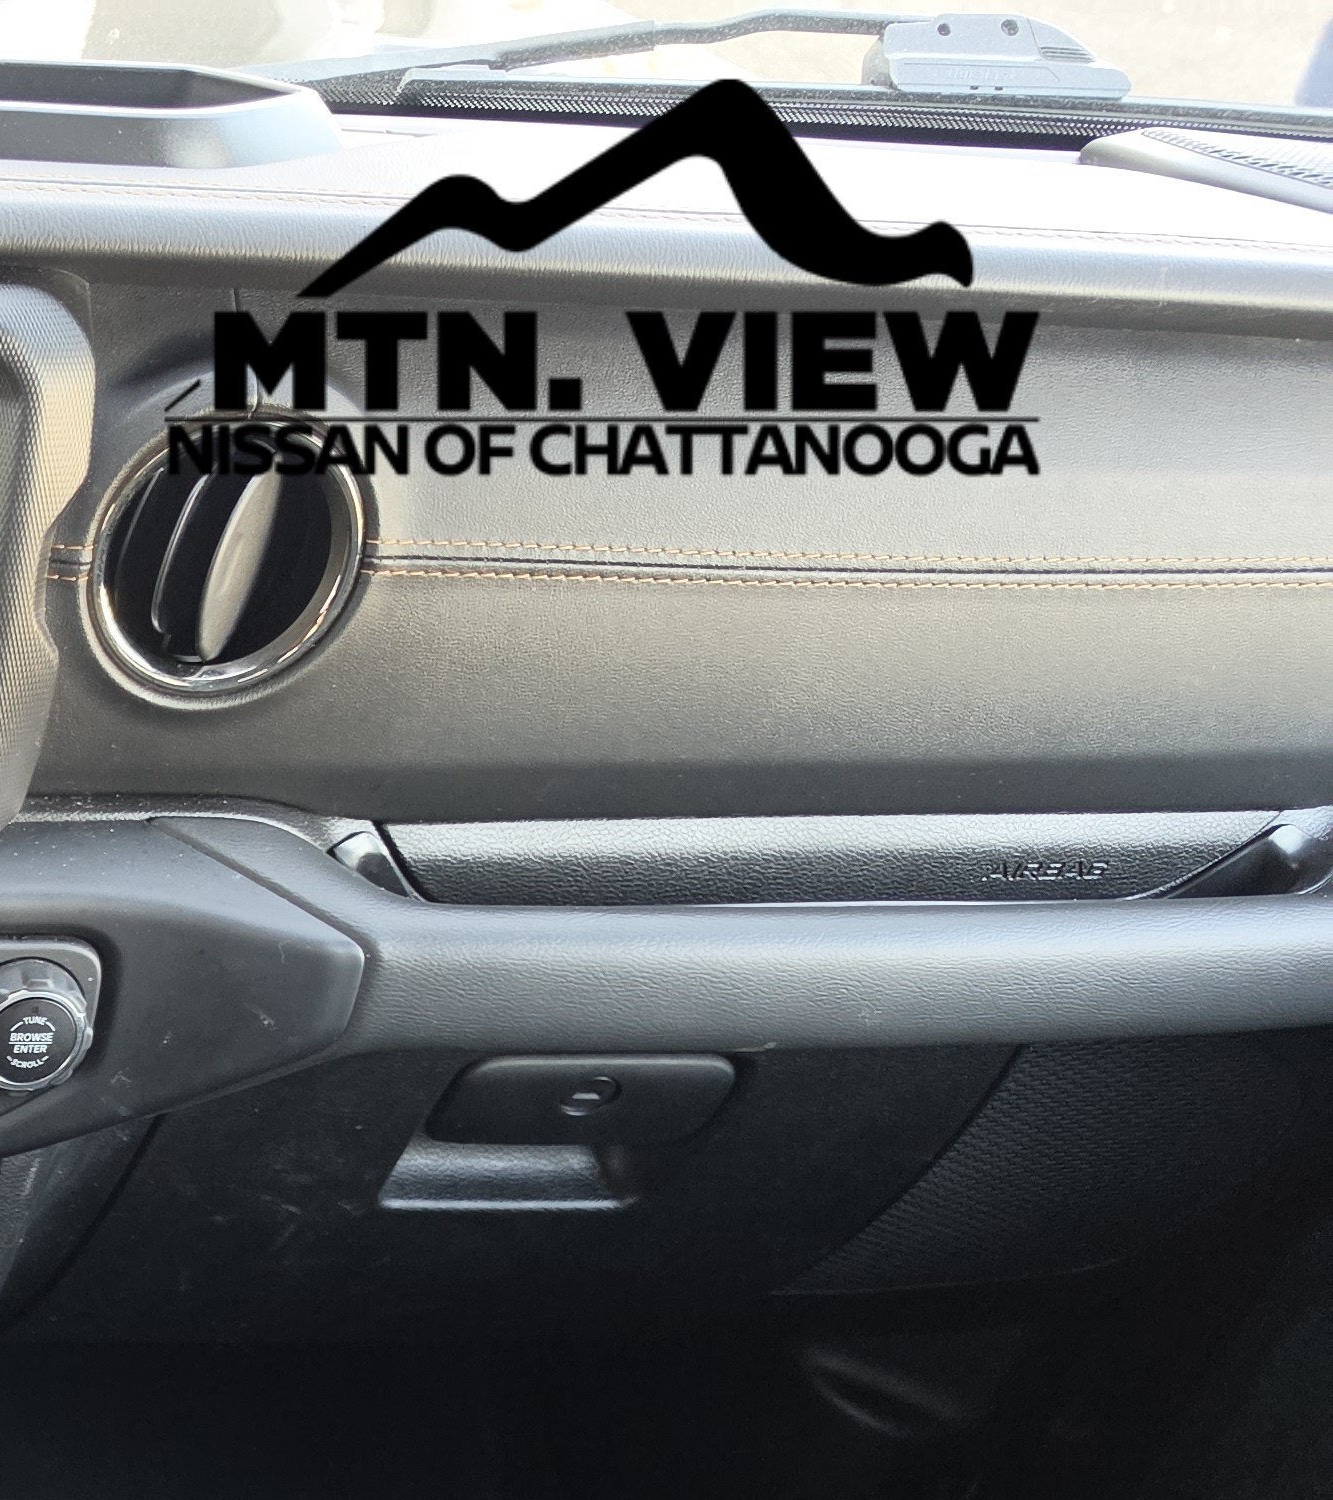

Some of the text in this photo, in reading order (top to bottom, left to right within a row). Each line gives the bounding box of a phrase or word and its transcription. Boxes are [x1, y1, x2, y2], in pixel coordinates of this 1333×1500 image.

[23, 1016, 47, 1025] TUNE
[9, 1032, 54, 1042] BROWSE
[13, 1045, 47, 1054] ENTER
[10, 1059, 44, 1069] SCROLL
